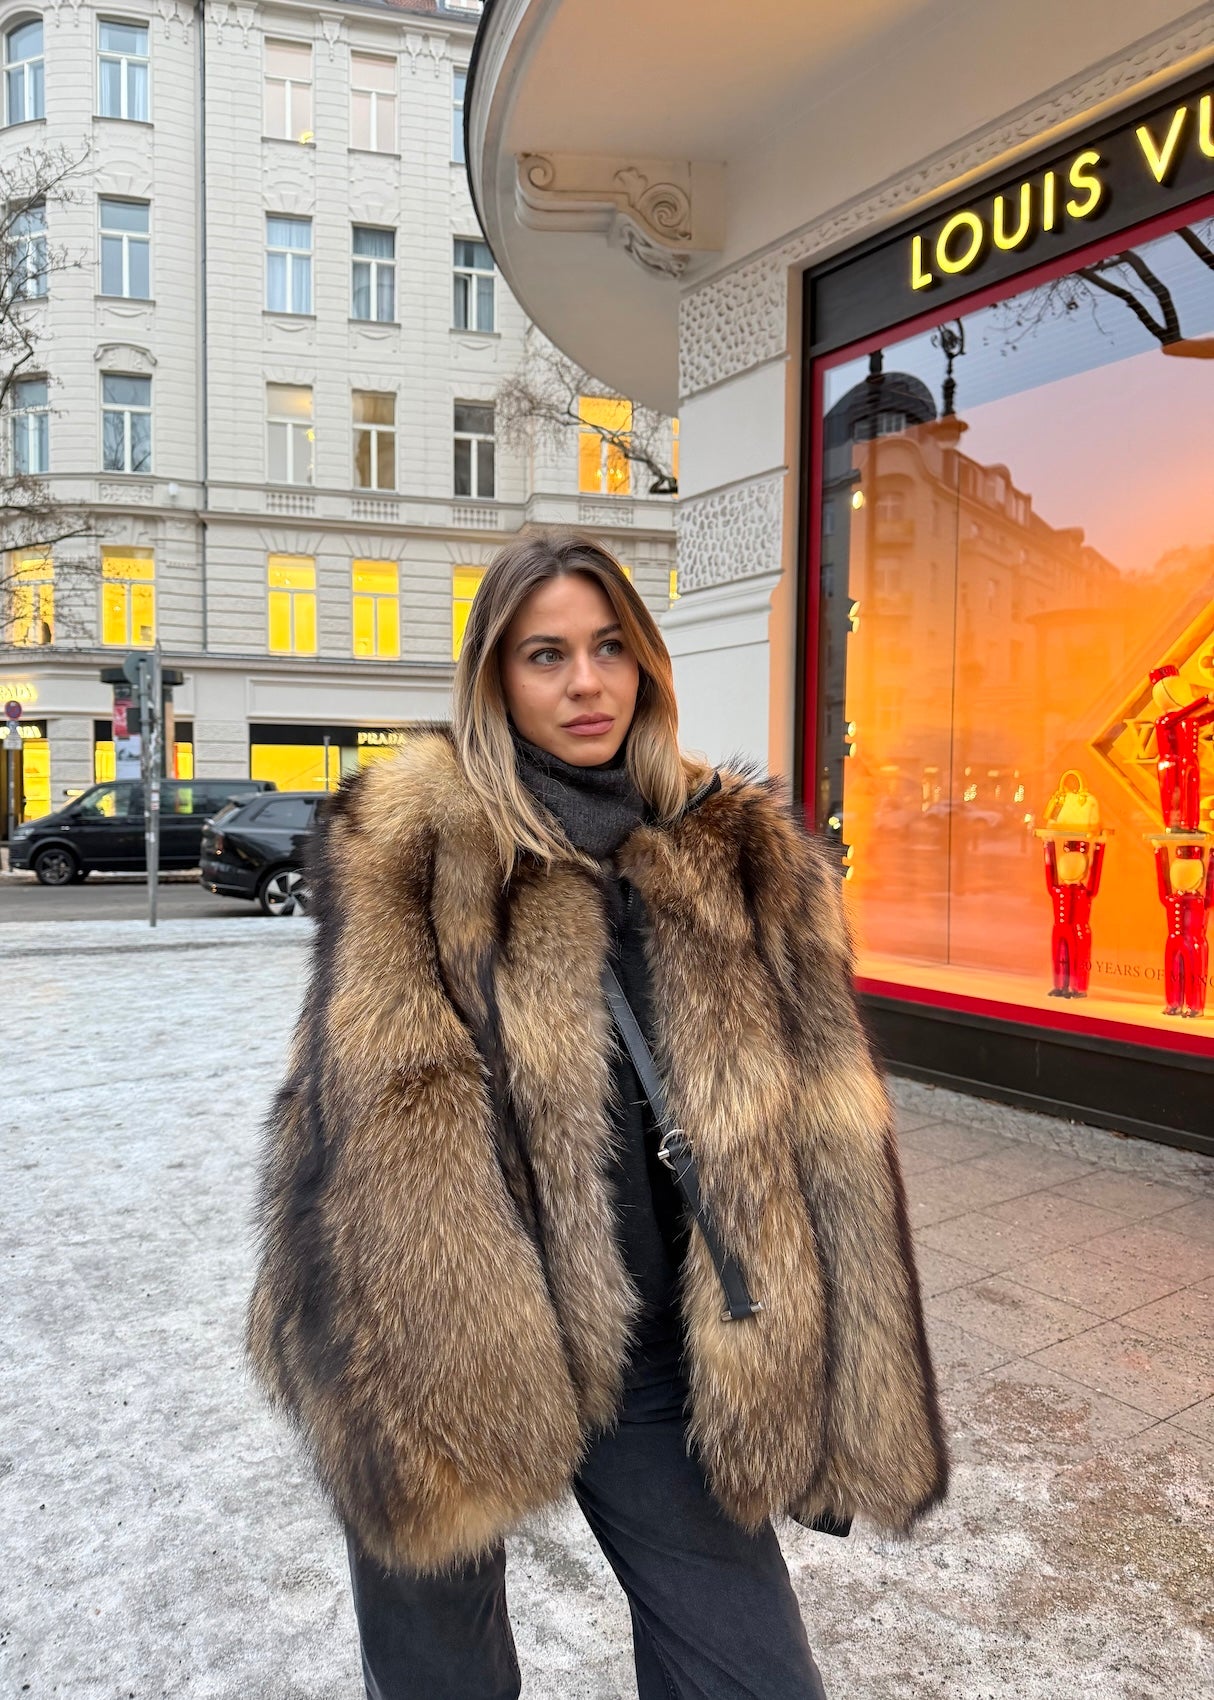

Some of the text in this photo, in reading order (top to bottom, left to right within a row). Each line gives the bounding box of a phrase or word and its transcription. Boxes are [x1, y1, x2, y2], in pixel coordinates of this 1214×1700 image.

[911, 150, 1103, 291] LOUIS
[357, 731, 408, 745] PRADA
[1096, 960, 1140, 978] YEARS
[1144, 966, 1165, 981] OF
